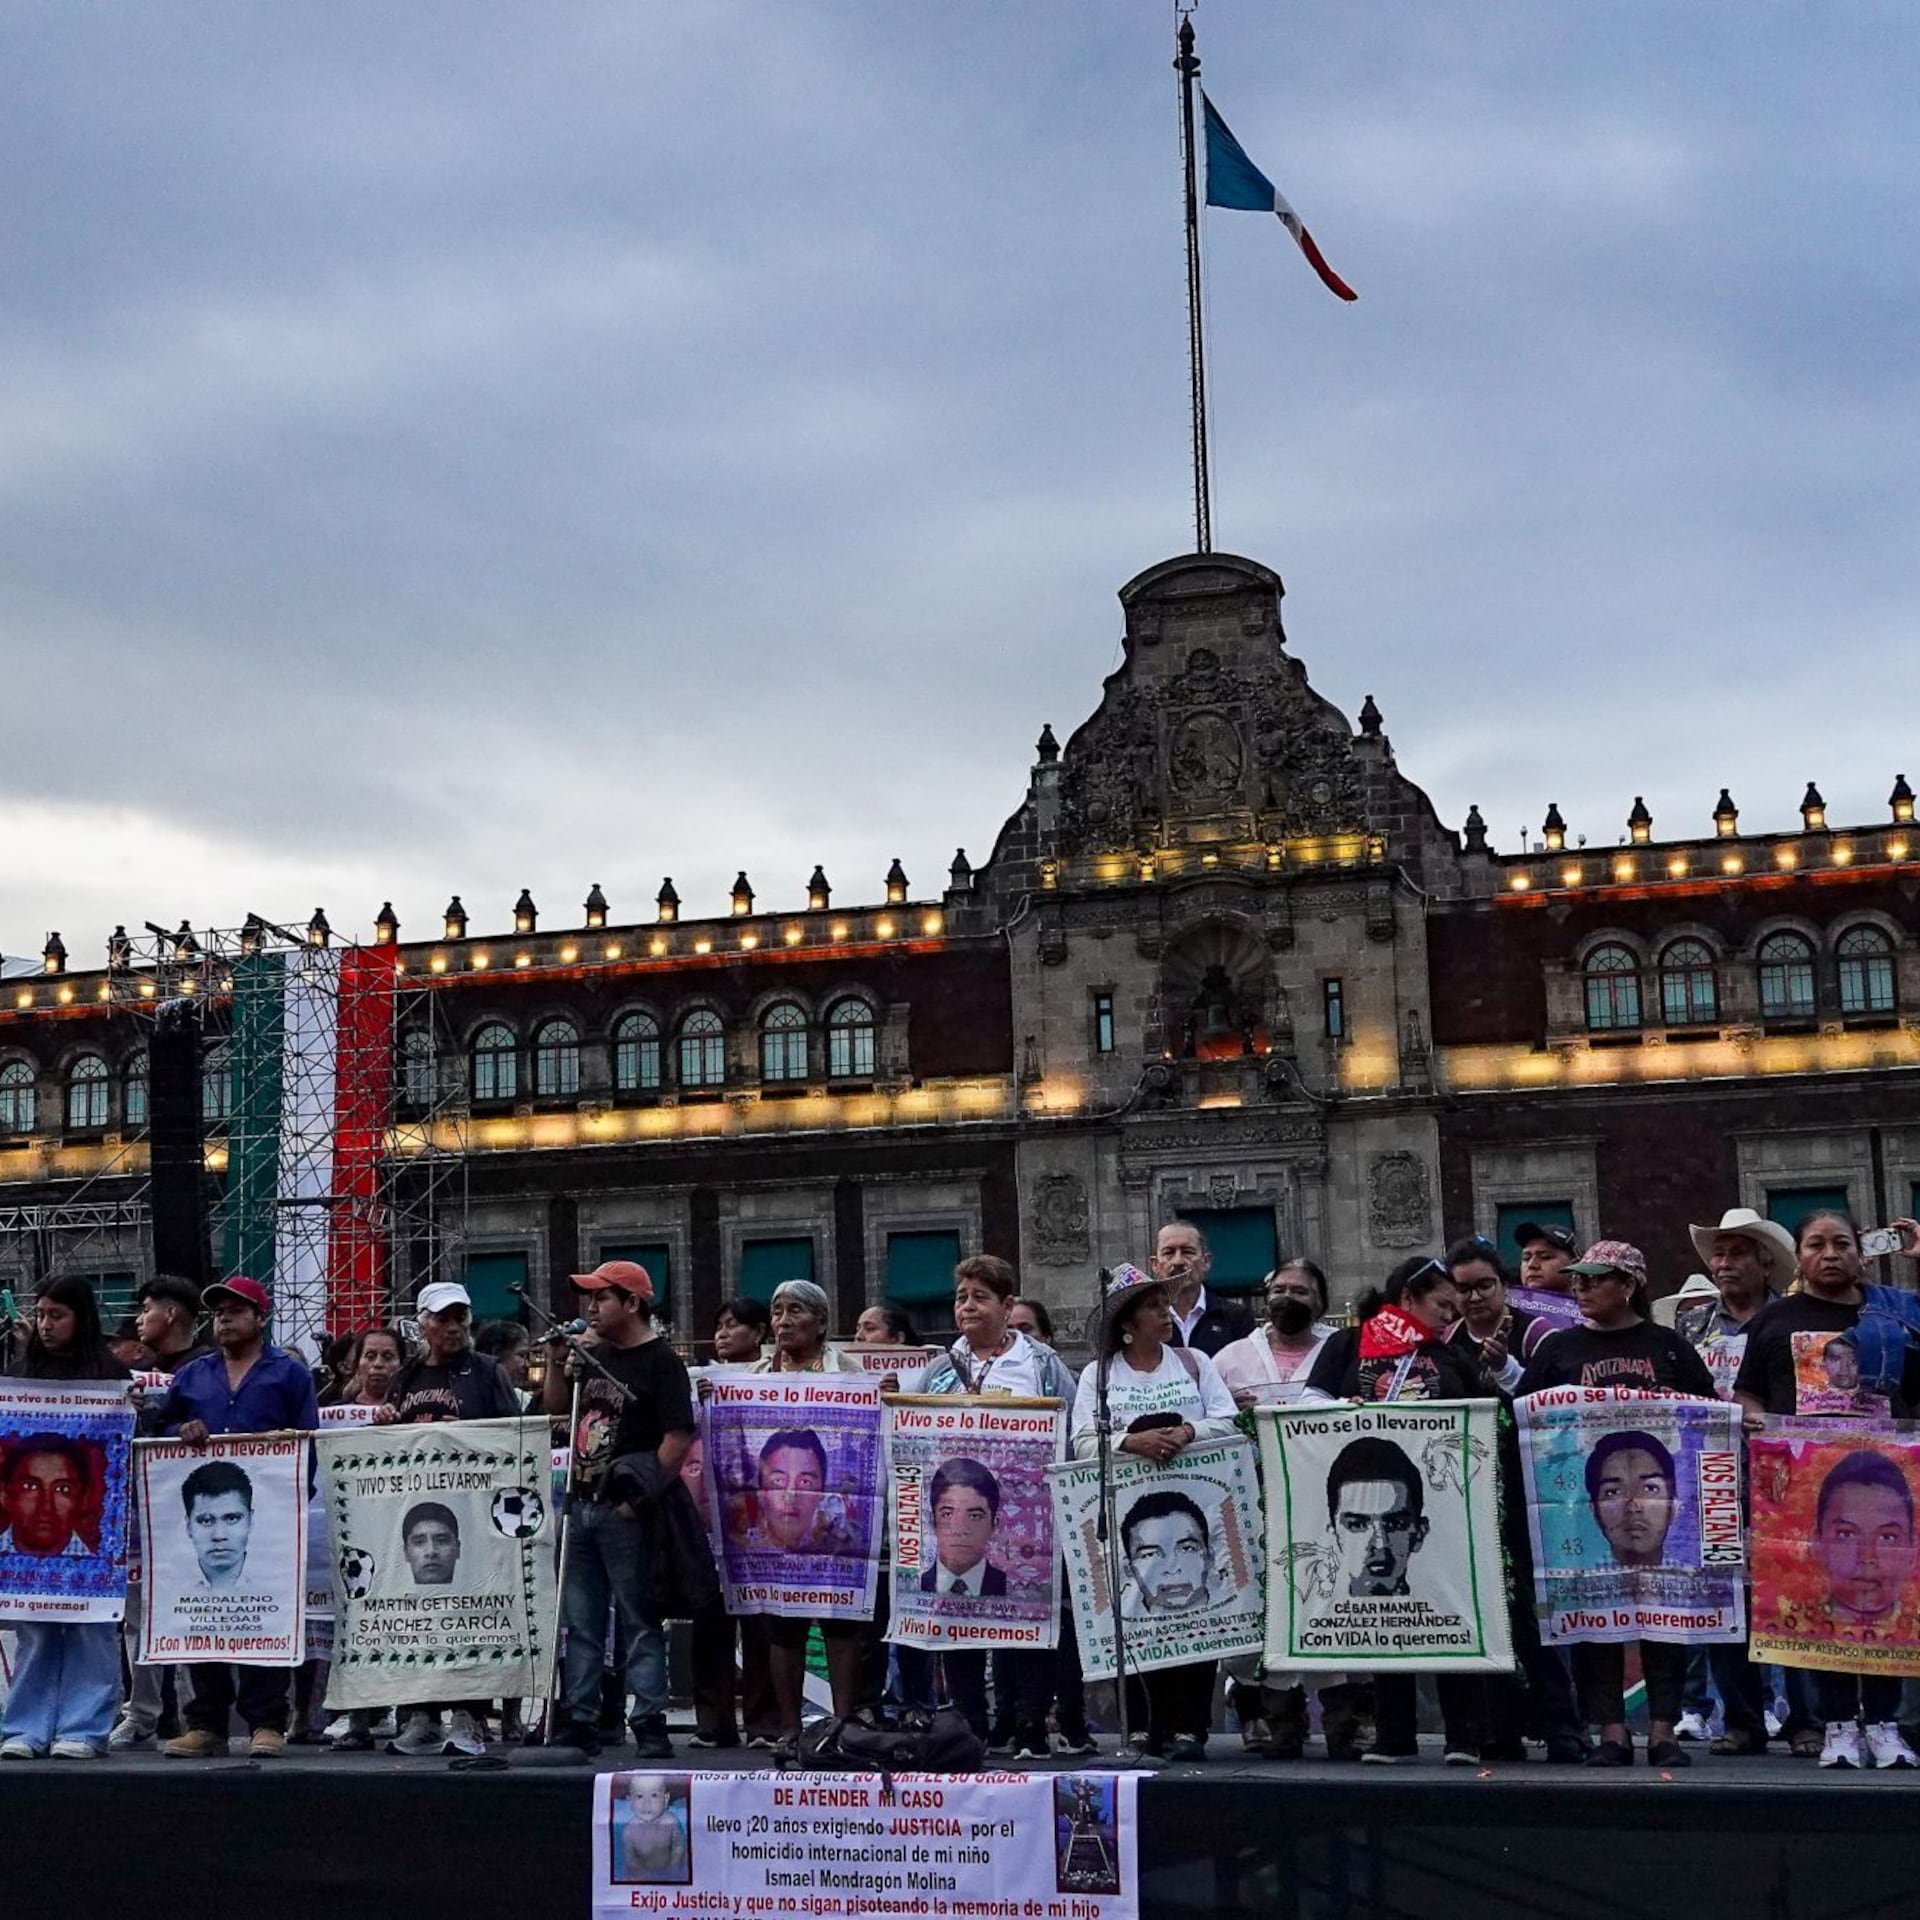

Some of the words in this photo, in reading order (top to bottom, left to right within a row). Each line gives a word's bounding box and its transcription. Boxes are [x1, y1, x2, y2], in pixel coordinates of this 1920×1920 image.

[1580, 1356, 1656, 1386] AYOTZINAPA
[17, 1393, 41, 1404] vivo
[45, 1396, 57, 1404] se
[61, 1395, 71, 1404] lo
[75, 1396, 127, 1406] llevaron!
[714, 1385, 754, 1405] ¡Vivo
[759, 1389, 779, 1402] se
[784, 1387, 799, 1402] lo
[804, 1387, 878, 1405] llevaron!
[1529, 1388, 1577, 1412] ¡Vivo
[1583, 1388, 1606, 1402] se
[1613, 1385, 1630, 1401] lo
[321, 1409, 345, 1420] ivo
[350, 1411, 367, 1420] se
[1110, 1402, 1156, 1412] SCENCIO
[894, 1409, 932, 1431] ¡Vivo
[936, 1414, 955, 1428] se
[959, 1411, 974, 1428] lo
[979, 1413, 1054, 1432] llevaron!
[1285, 1418, 1329, 1439] ¡Vivo
[1333, 1419, 1351, 1432] se
[1355, 1414, 1372, 1431] lo
[1376, 1413, 1456, 1431] llevaron!
[230, 1440, 296, 1457] llevaron!
[1070, 1469, 1103, 1488] ¡Viv
[1116, 1466, 1132, 1480] se
[1137, 1462, 1150, 1475] lo
[1156, 1449, 1227, 1472] llevaron!
[1702, 1452, 1736, 1483] NOS
[390, 1475, 403, 1492] SE
[408, 1474, 422, 1491] LO
[426, 1472, 492, 1490] LLEVARON!
[1555, 1472, 1577, 1490] 43
[899, 1537, 919, 1566] NOS
[1561, 1537, 1584, 1556] 43
[14, 1599, 25, 1608] lo
[28, 1601, 89, 1611] queremos!
[179, 1596, 273, 1604] MAGDALENO
[364, 1594, 417, 1612] MARTÍN
[421, 1595, 516, 1611] GETSEMANY
[783, 1590, 854, 1605] ueremos!
[1334, 1600, 1377, 1614] CÉSAR
[1379, 1602, 1433, 1614] MANUEL
[173, 1605, 223, 1614] RUBÉN
[226, 1605, 279, 1613] LAURO
[190, 1615, 261, 1623] VILLEGAS
[234, 1624, 263, 1632] AÑOS
[359, 1614, 433, 1633] SÁNCHEZ
[440, 1611, 512, 1631] GARCÍA
[899, 1617, 925, 1635] ¡Vivo
[928, 1620, 941, 1636] lo
[947, 1626, 1040, 1641] queremos!
[1309, 1615, 1378, 1628] GONZÁLEZ
[1381, 1614, 1461, 1628] HERNÁNDEZ
[1561, 1611, 1607, 1633] ¡Vivo
[1613, 1610, 1630, 1626] lo
[1635, 1610, 1723, 1628] queremos!
[388, 1633, 420, 1645] VIDA
[426, 1633, 438, 1645] lo
[445, 1632, 521, 1647] queremos!
[1101, 1628, 1153, 1647] BEJAMÍN
[1155, 1619, 1207, 1636] ASCENCIO
[1299, 1632, 1332, 1649] ¡Con
[1334, 1632, 1373, 1646] VIDA
[1375, 1631, 1389, 1646] lo
[1392, 1630, 1471, 1650] queremos!
[154, 1636, 179, 1653] ¡Con
[184, 1635, 210, 1650] VIDA
[214, 1635, 225, 1650] lo
[229, 1635, 290, 1652] queremos!
[1137, 1646, 1173, 1661] VIDA
[1176, 1642, 1188, 1655] lo
[1192, 1632, 1264, 1653] queremos!
[1755, 1638, 1810, 1652] CHRISTIAN
[774, 1788, 793, 1806] DE
[799, 1789, 869, 1807] ATENDER
[902, 1790, 943, 1808] CASO
[707, 1815, 741, 1832] llevo
[746, 1815, 769, 1836] ¡20
[774, 1816, 808, 1833] años
[813, 1818, 884, 1839] exigiendo
[889, 1818, 962, 1836] JUSTICIA
[971, 1821, 996, 1841] por
[1001, 1820, 1014, 1837] el
[731, 1842, 803, 1860] homicidio
[808, 1843, 907, 1863] internacional
[911, 1846, 930, 1863] de
[935, 1847, 952, 1863] mi
[958, 1846, 990, 1864] niño
[766, 1868, 815, 1887] Ismael
[820, 1869, 902, 1893] Mondragón
[907, 1872, 956, 1890] Molina
[631, 1890, 667, 1912] Exijo
[672, 1890, 729, 1909] Justicia
[733, 1896, 745, 1914] y
[746, 1896, 773, 1915] que
[778, 1897, 796, 1911] no
[801, 1894, 842, 1916] sigan
[846, 1896, 928, 1915] pisoteando
[934, 1897, 947, 1914] la
[952, 1897, 1018, 1916] memoria
[1023, 1898, 1043, 1917] de
[1049, 1899, 1066, 1917] mi
[1071, 1899, 1100, 1920] hijo
